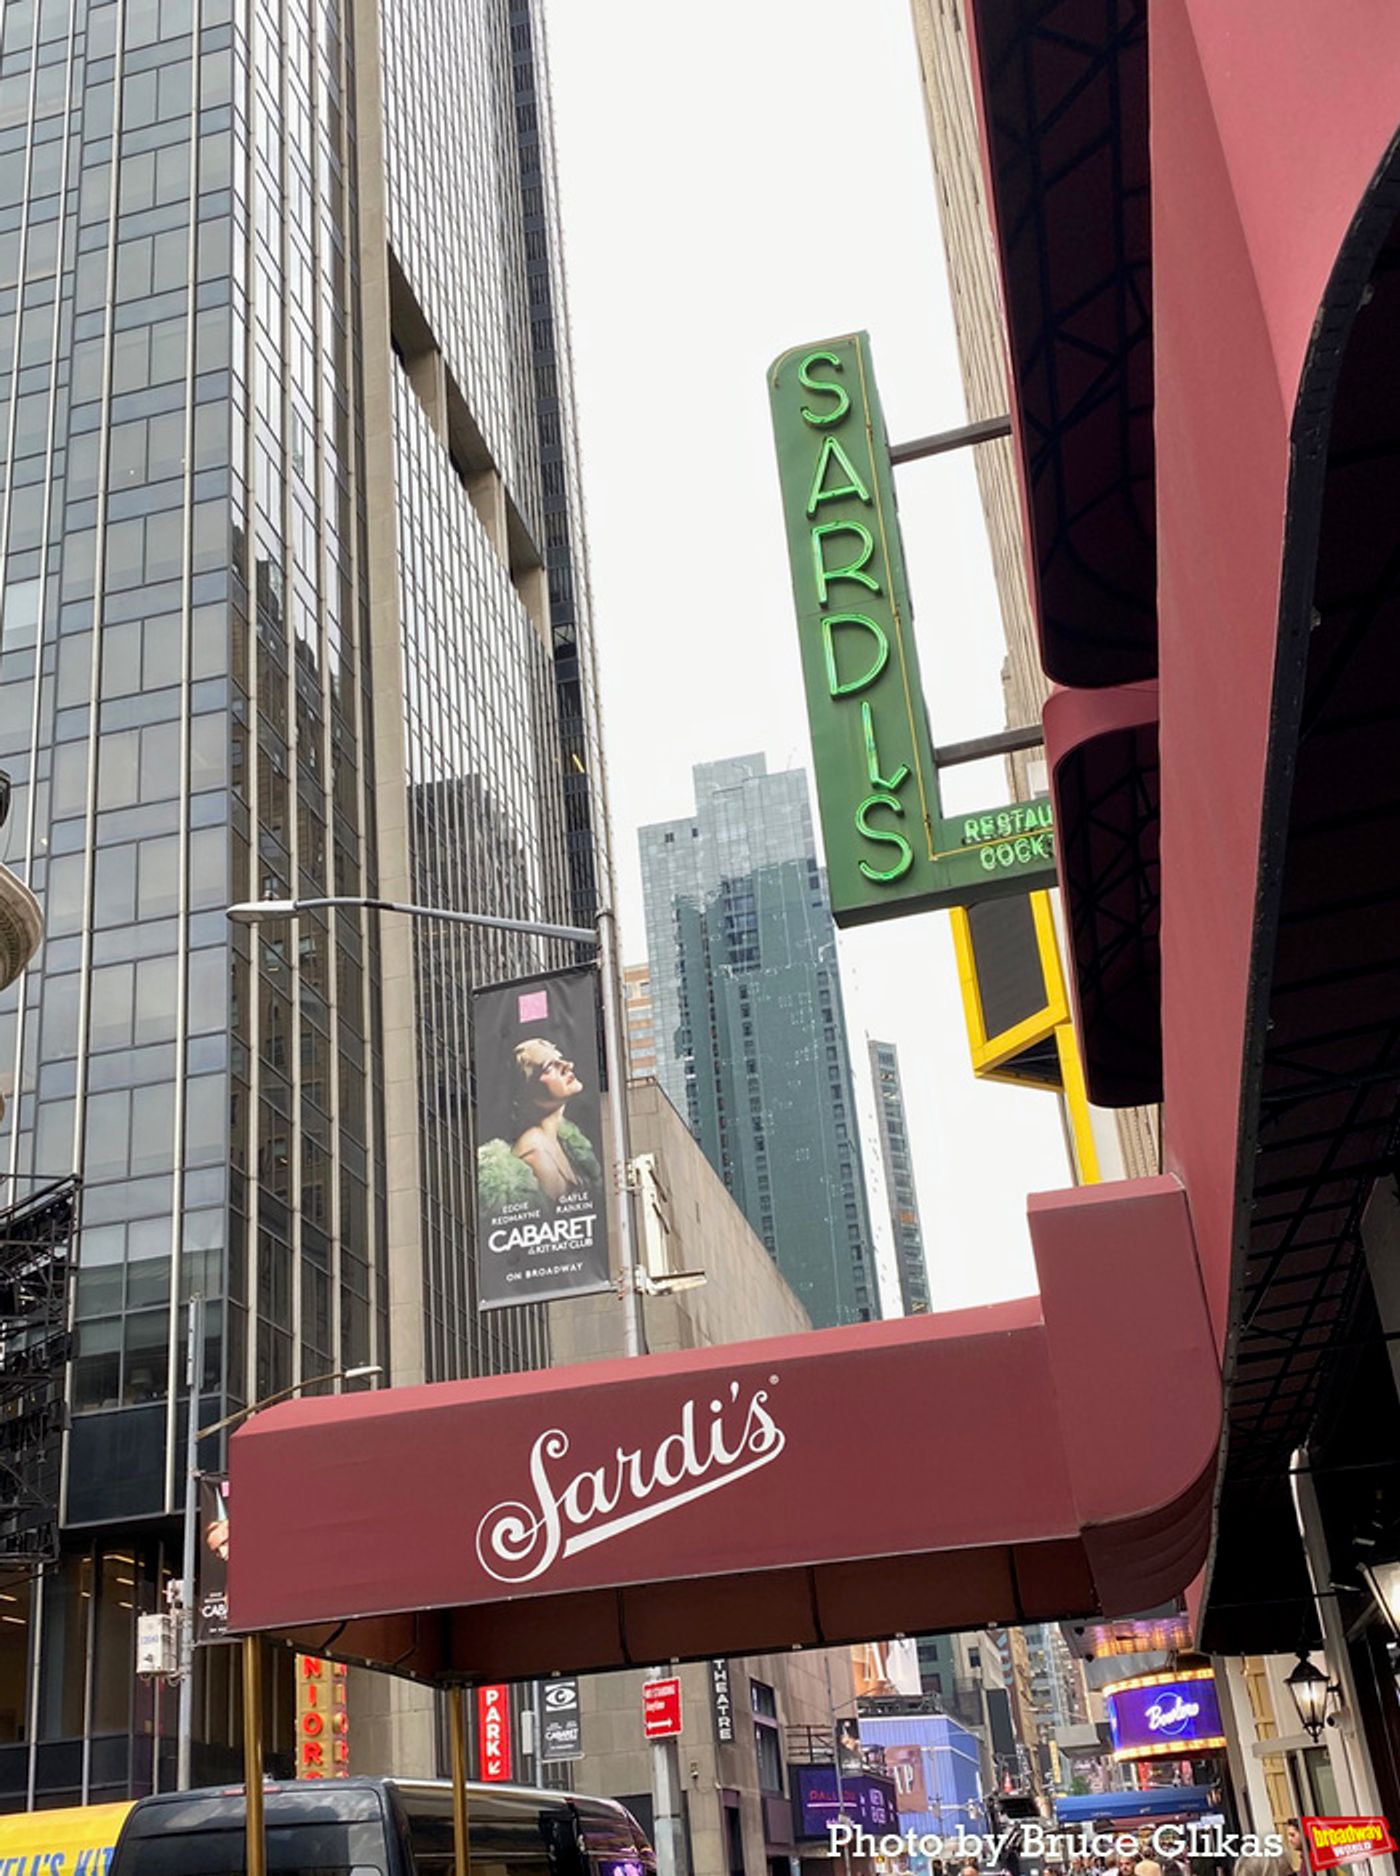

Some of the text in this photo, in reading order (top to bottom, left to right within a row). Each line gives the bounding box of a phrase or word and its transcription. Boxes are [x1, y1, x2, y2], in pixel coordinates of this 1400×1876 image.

[964, 804, 1053, 844] RESTAU
[488, 1214, 597, 1253] CABARET
[506, 1262, 584, 1282] ON BROADWAY
[476, 1381, 786, 1584] Sardi's
[713, 1659, 732, 1740] THEATRE
[486, 1690, 501, 1757] PARK
[1312, 1824, 1383, 1847] broadway
